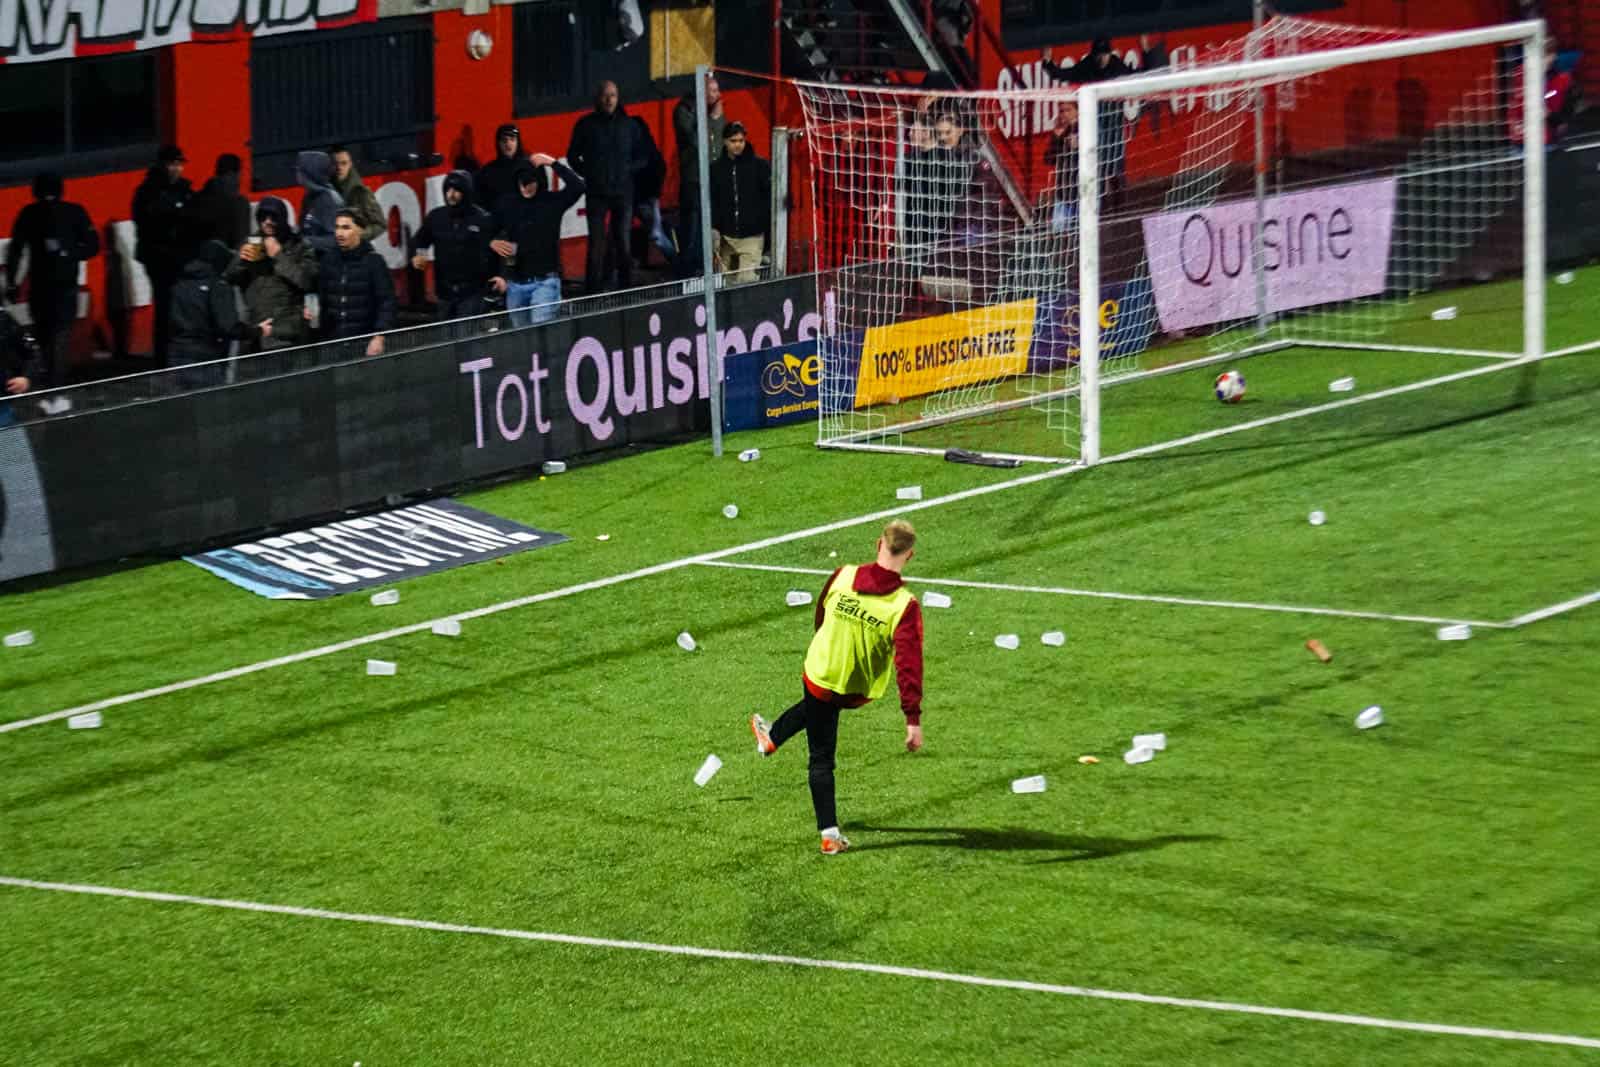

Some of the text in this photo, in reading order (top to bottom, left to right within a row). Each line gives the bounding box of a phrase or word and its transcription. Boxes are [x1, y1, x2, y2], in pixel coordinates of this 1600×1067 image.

[1179, 207, 1353, 287] Quisine
[874, 327, 1016, 379] 100% EMISSION FREE
[459, 353, 551, 449] Tot
[231, 504, 542, 585] BETCITY.NL
[835, 602, 888, 628] saller
